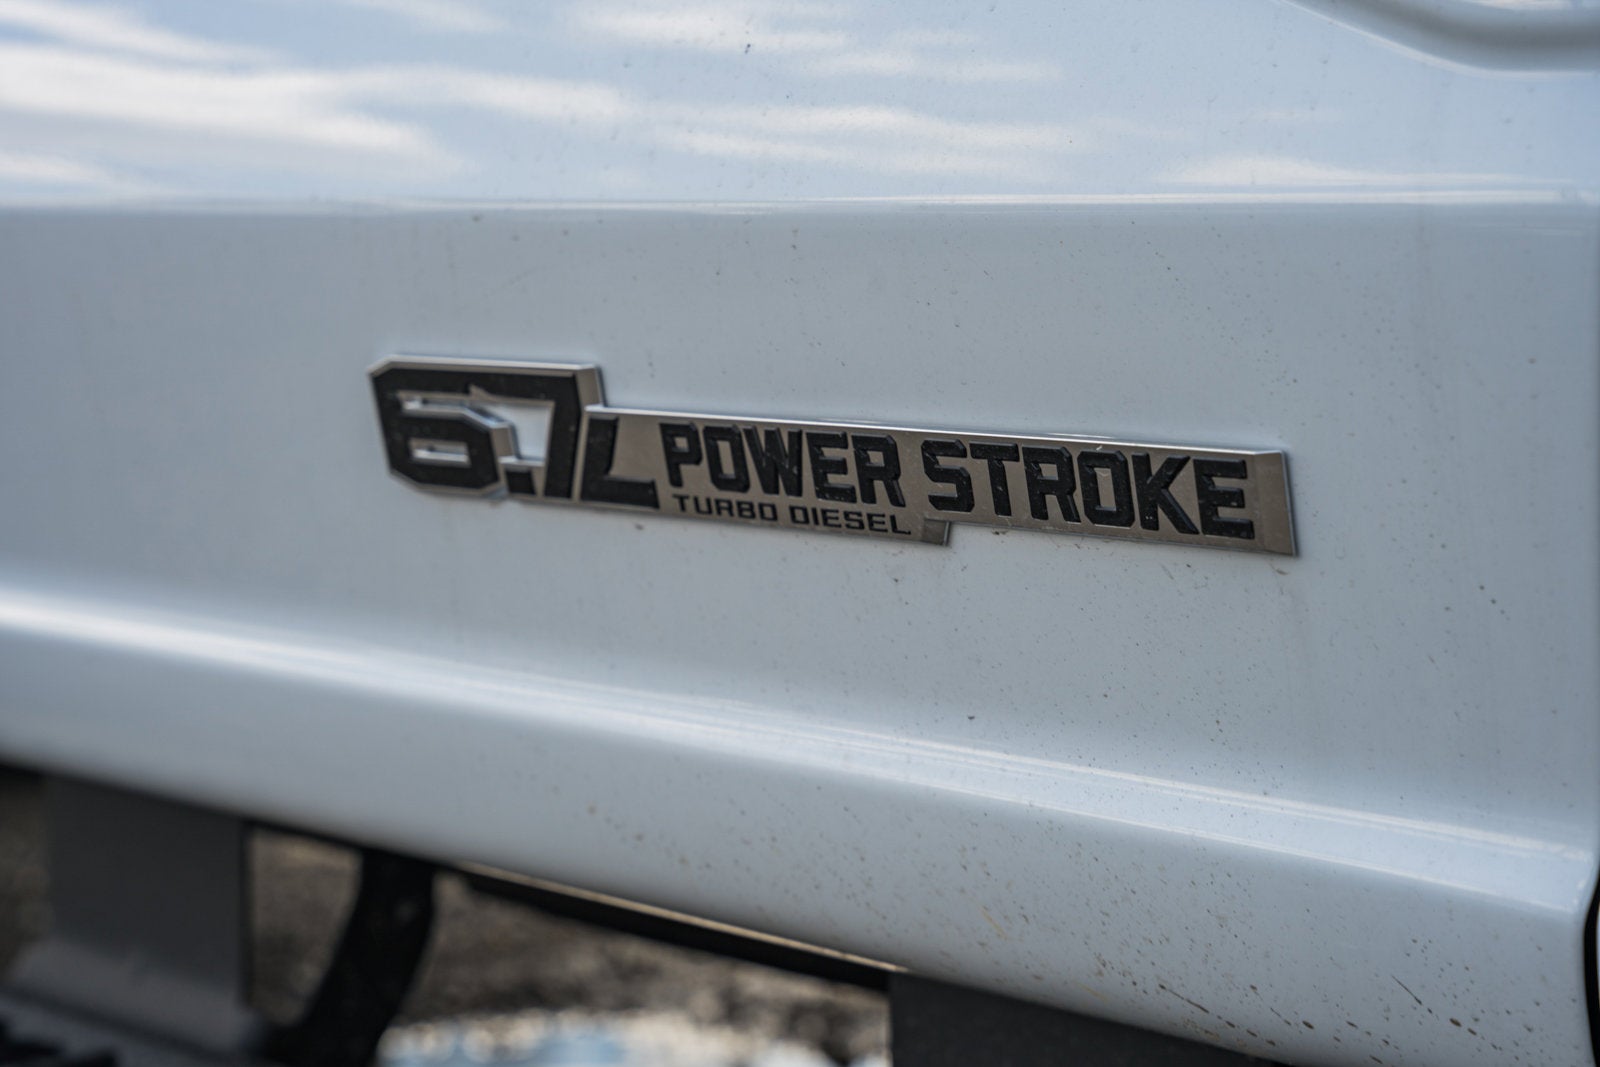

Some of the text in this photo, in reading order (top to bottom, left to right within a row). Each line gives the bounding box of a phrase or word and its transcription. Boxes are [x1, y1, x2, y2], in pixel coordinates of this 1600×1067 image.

[371, 364, 1255, 540] 6.7L POWER STROKE
[672, 493, 912, 535] TURBO DIESEL
